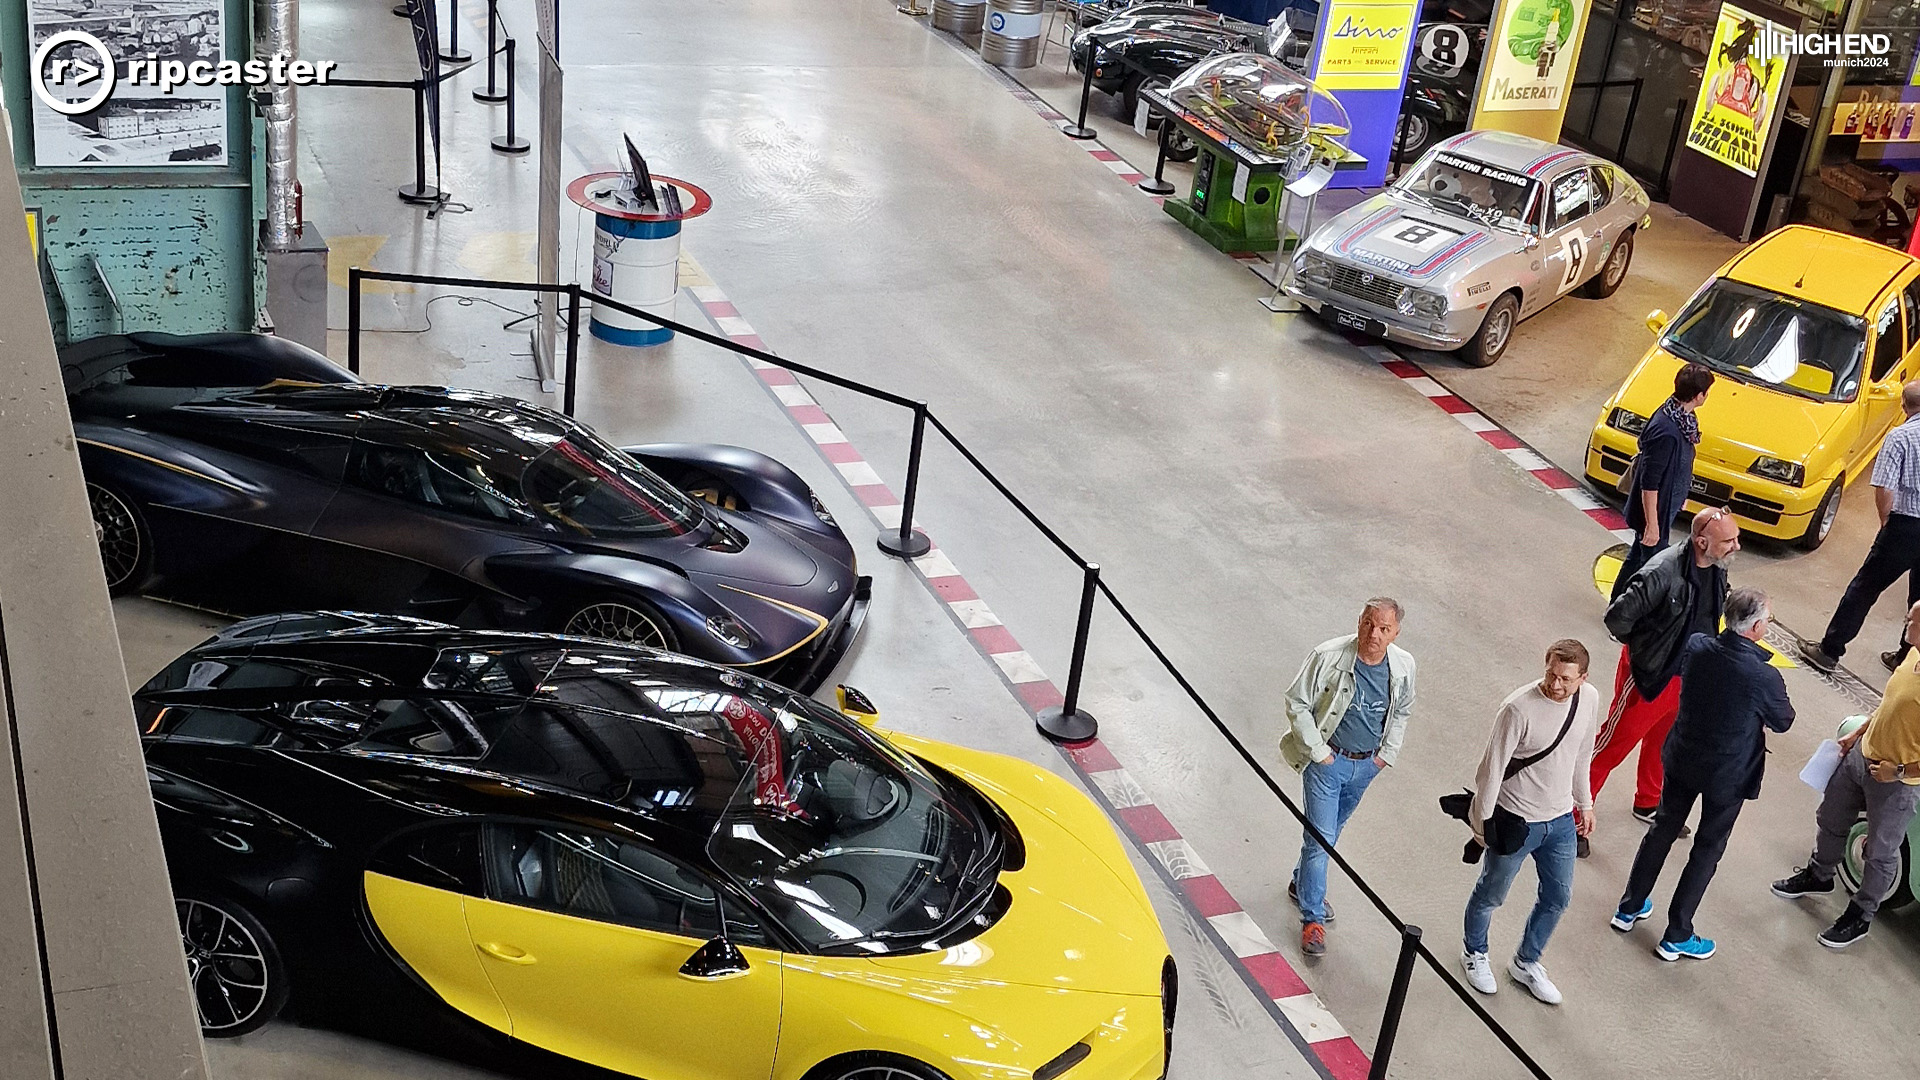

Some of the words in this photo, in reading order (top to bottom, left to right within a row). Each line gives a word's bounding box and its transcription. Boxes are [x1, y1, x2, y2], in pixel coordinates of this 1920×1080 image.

[1334, 16, 1402, 38] Dino
[1432, 28, 1459, 66] 8
[1492, 77, 1557, 100] MASERATI
[1695, 119, 1758, 157] FERRARI
[1437, 154, 1481, 174] MARTINI
[1481, 167, 1528, 187] RACING
[1393, 225, 1438, 244] 8
[1353, 249, 1410, 270] MARTINI
[1565, 237, 1582, 286] 8
